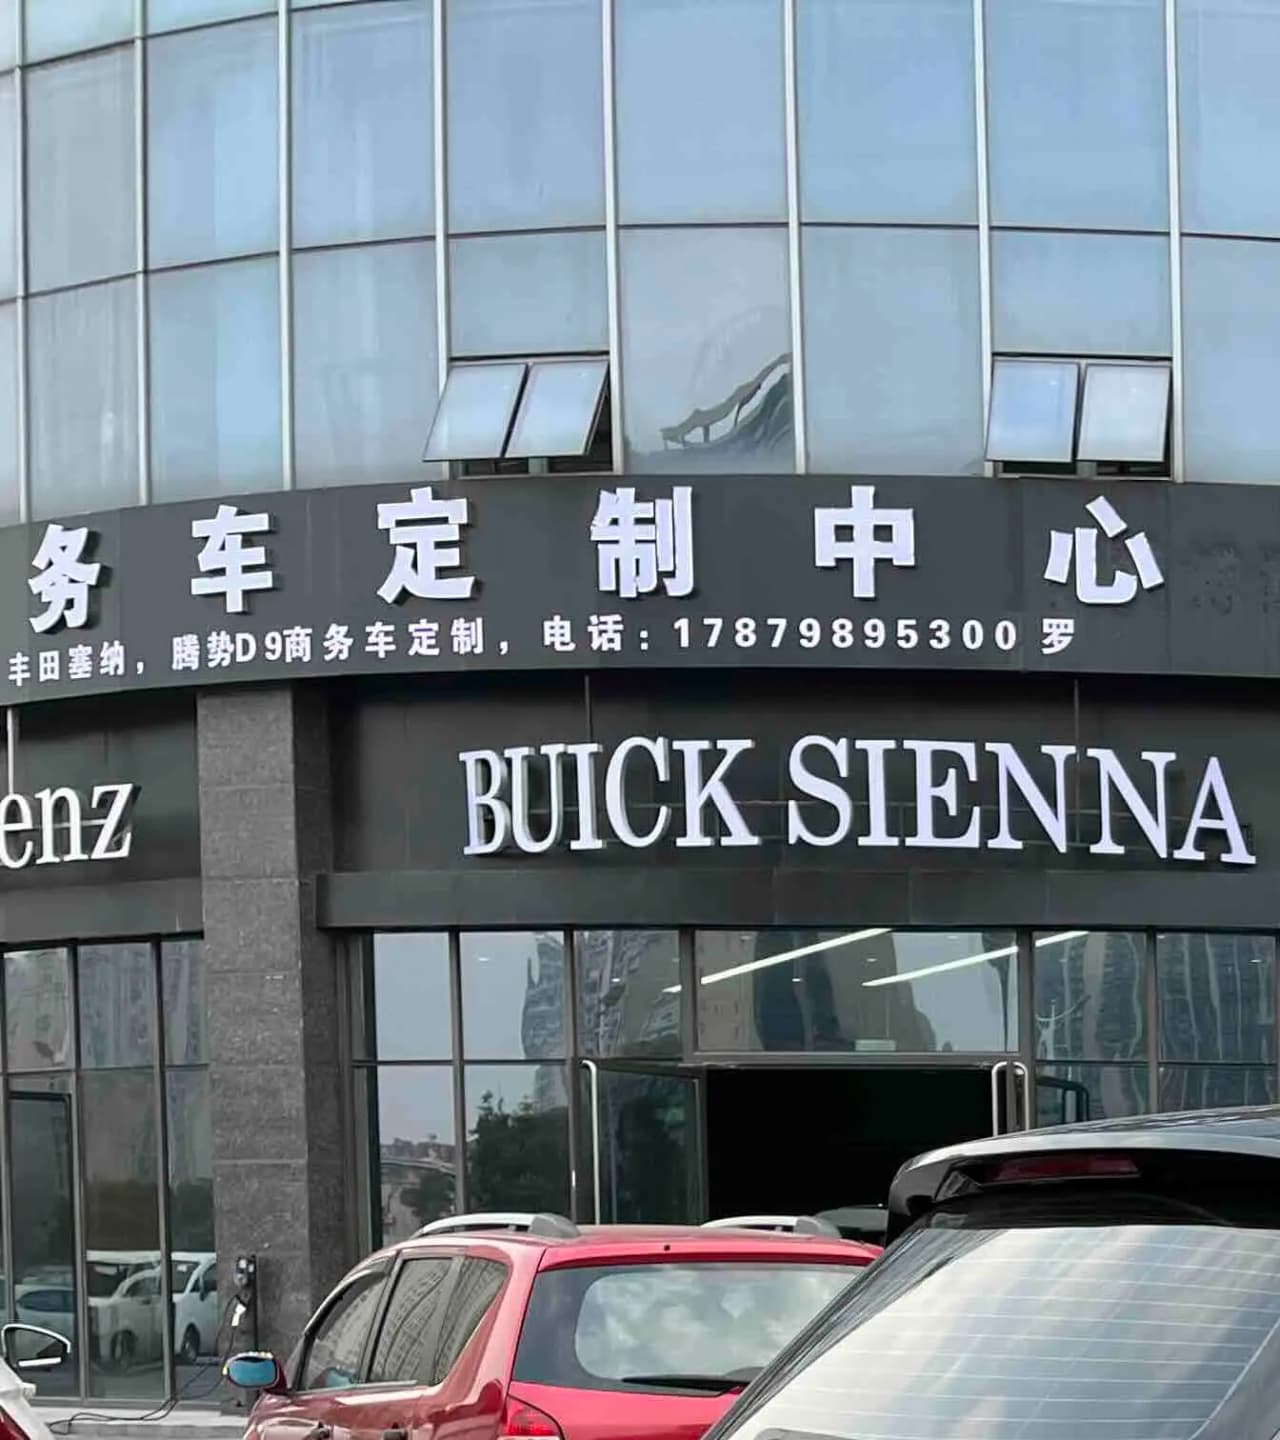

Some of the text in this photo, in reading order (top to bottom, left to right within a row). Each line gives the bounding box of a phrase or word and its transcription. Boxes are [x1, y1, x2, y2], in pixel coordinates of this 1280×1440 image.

[1041, 618, 1075, 655] 罗
[0, 783, 133, 869] enz
[459, 735, 1257, 865] BUICK SIENNA
